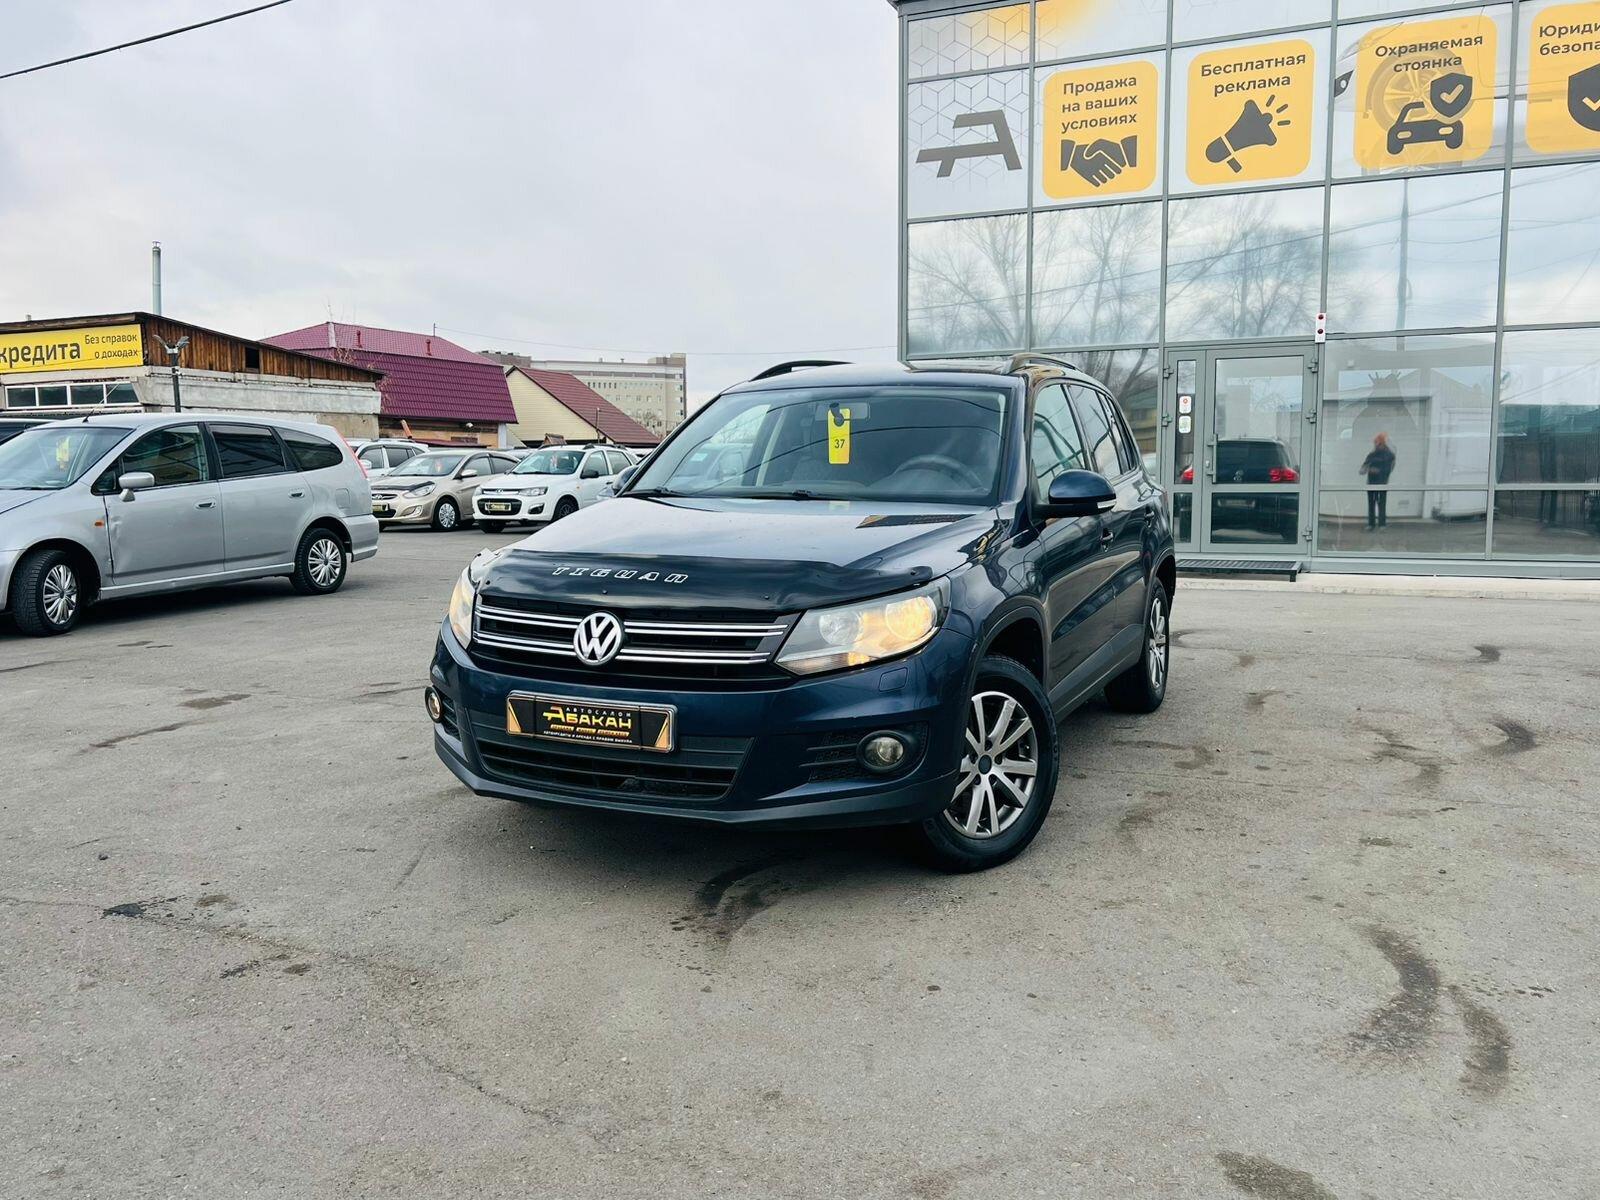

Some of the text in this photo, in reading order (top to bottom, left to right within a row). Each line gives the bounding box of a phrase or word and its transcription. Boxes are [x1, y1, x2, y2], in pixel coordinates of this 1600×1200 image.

[1375, 35, 1483, 57] Охраняемая
[1201, 54, 1306, 77] Бесплатная
[1393, 56, 1462, 73] стоянка
[1063, 76, 1137, 96] Продажа
[1214, 75, 1291, 97] реклама
[1062, 95, 1138, 113] на ваших
[1061, 113, 1137, 134] условиях
[85, 334, 137, 345] Без справок
[95, 349, 138, 360] о доходах
[834, 438, 846, 449] 37
[552, 566, 688, 583] TIGUAN
